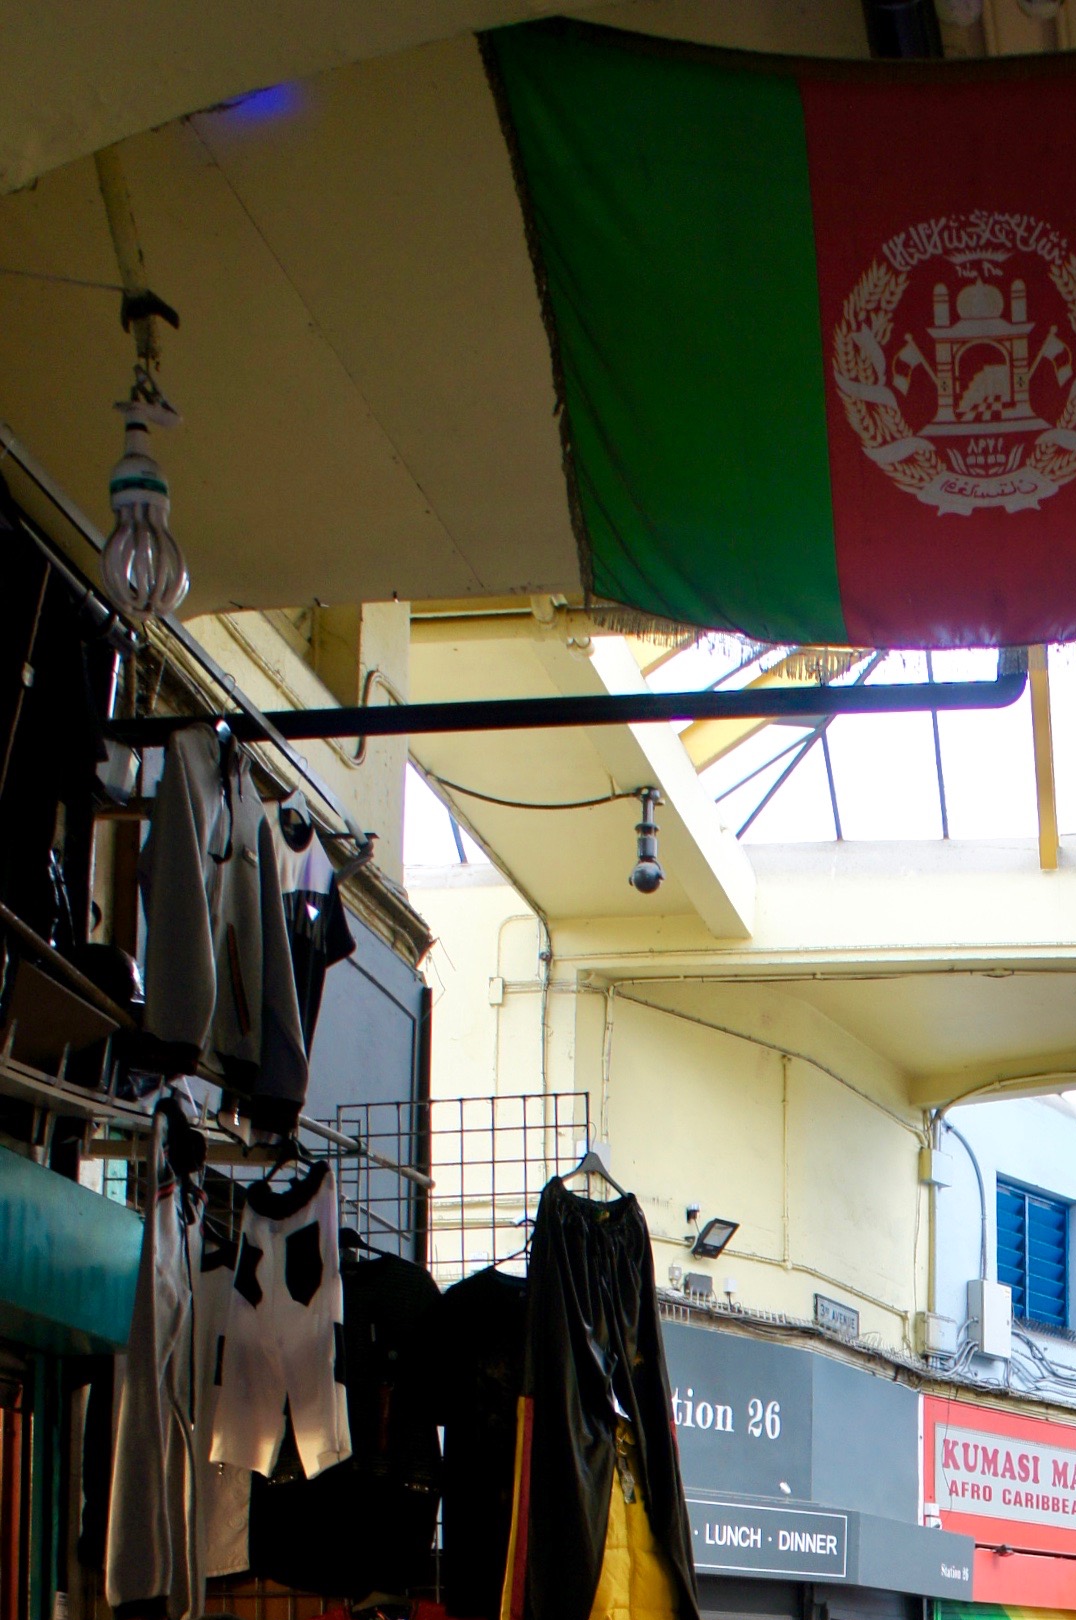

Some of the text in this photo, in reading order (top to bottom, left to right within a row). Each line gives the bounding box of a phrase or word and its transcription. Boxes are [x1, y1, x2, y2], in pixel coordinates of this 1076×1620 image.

[747, 1398, 781, 1440] 26
[942, 1438, 1041, 1484] KUMASI
[949, 1479, 993, 1502] AFRO
[705, 1522, 838, 1556] LUNCH DINNER
